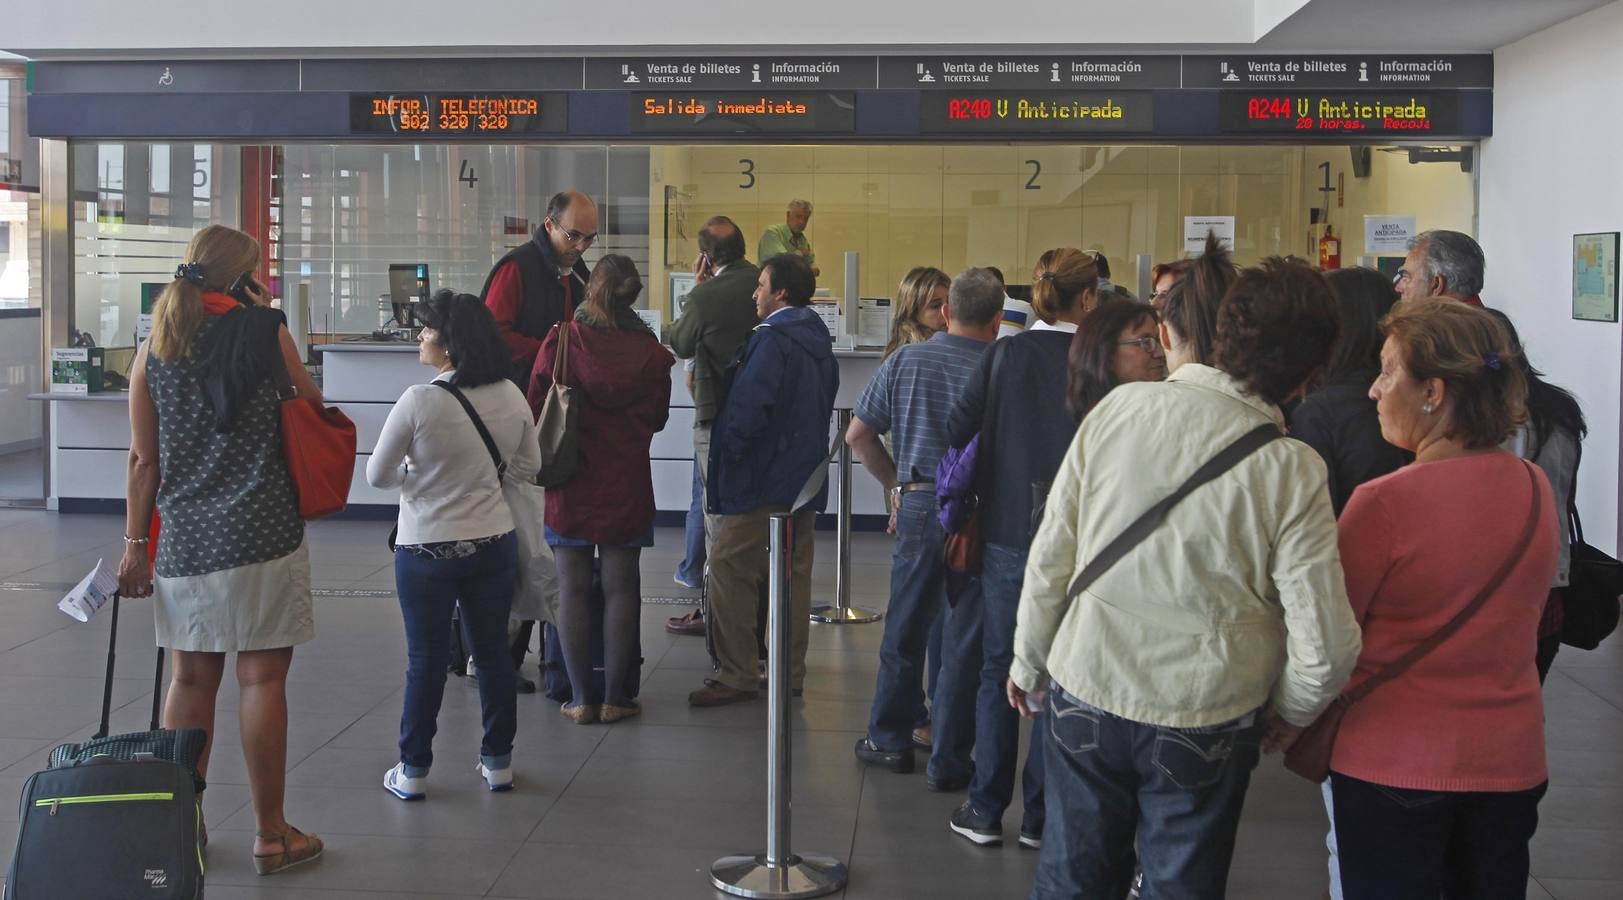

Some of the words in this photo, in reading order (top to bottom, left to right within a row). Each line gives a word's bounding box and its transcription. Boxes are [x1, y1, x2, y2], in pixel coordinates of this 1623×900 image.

[647, 63, 679, 75] Venta
[681, 63, 697, 75] de
[699, 63, 741, 75] billetes
[771, 62, 840, 74] Información
[943, 62, 975, 74] Venta
[978, 62, 994, 74] de
[996, 62, 1040, 74] billetes
[1071, 61, 1142, 73] Información
[1247, 61, 1281, 73] Venta
[1284, 61, 1300, 73] de
[1303, 61, 1347, 73] billetes
[1379, 60, 1452, 73] Información
[1248, 74, 1276, 82] TICKETS
[1277, 74, 1296, 82] SALE
[1379, 74, 1431, 82] INFORMATION
[372, 99, 429, 115] INFOR.
[440, 99, 538, 115] TELEFONICA
[644, 98, 706, 115] Salida
[717, 98, 807, 114] inmediata
[949, 99, 991, 119] A240
[997, 99, 1009, 119] V
[1017, 99, 1123, 120] Anticipada
[1248, 98, 1291, 119] A244
[1297, 98, 1309, 118] V
[1319, 98, 1426, 118] Anticipada
[400, 114, 430, 129] 902
[439, 114, 469, 129] 320
[478, 114, 508, 129] 320
[1295, 117, 1314, 129] 20
[1319, 117, 1366, 129] horas.
[458, 159, 479, 189] 4
[738, 158, 755, 189] 3
[1024, 159, 1041, 190] 2
[1318, 161, 1336, 191] 1
